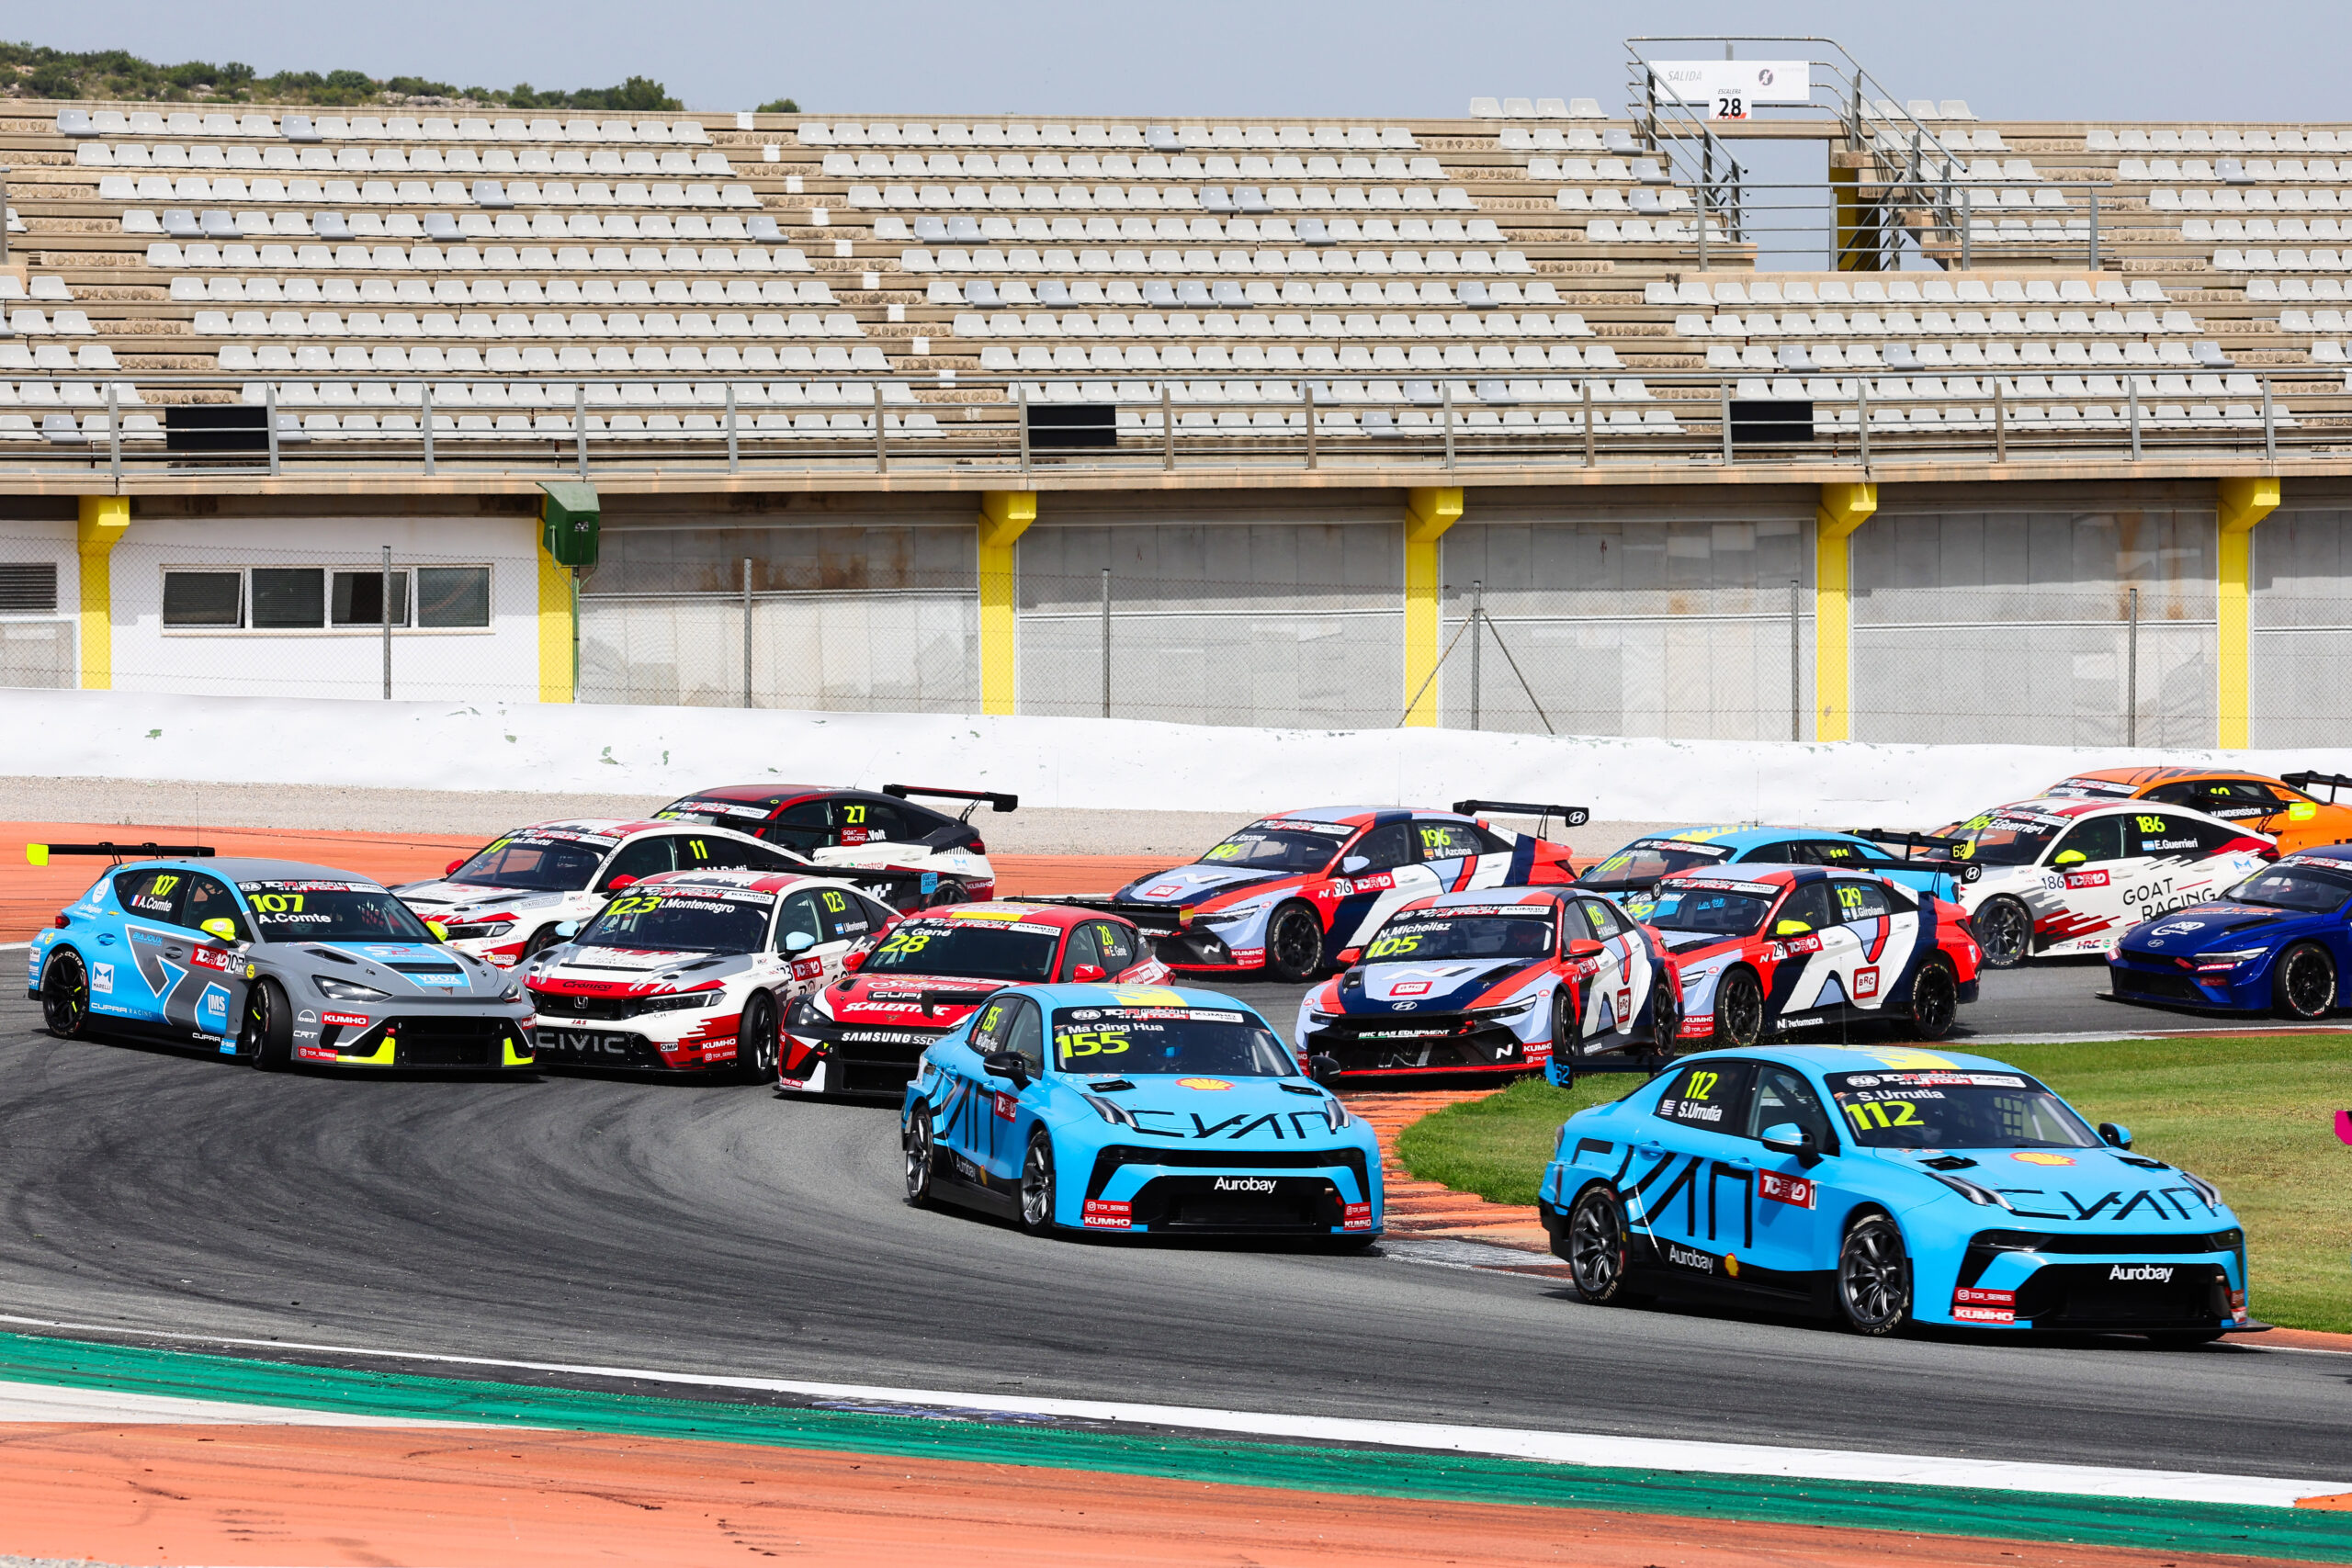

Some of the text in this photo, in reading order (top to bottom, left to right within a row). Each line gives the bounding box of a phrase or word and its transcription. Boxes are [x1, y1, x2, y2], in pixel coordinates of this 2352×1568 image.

[1668, 71, 1702, 82] SALIDA
[1719, 98, 1742, 117] 28
[843, 806, 865, 824] 27
[2136, 816, 2165, 833] 186
[1420, 829, 1452, 848] 196
[2154, 838, 2198, 850] E.Guerrieri
[482, 838, 514, 854] 11
[689, 840, 708, 860] 11
[1445, 847, 1472, 856] Azcona
[1952, 844, 1966, 858] 62
[855, 862, 884, 870] Castrol
[151, 874, 179, 896] 107
[967, 881, 993, 890] KUMHO
[1335, 881, 1352, 895] 96
[2041, 875, 2064, 890] 186
[730, 892, 771, 900] KUMHO
[1837, 886, 1862, 907] 129
[2122, 877, 2173, 906] GOAT
[139, 897, 173, 912] A.Comte
[248, 894, 304, 913] 107
[605, 897, 662, 917] 123
[658, 897, 736, 914] I.Montenegro
[822, 891, 846, 913] 123
[2142, 887, 2216, 921] RACING
[259, 913, 332, 924] A.Comte
[1587, 905, 1605, 926] 105
[911, 928, 952, 937] Gené
[1096, 925, 1114, 945] 28
[1377, 921, 1453, 940] N.Michelisz
[878, 935, 931, 953] 28
[1365, 935, 1424, 959] 105
[2076, 940, 2101, 950] HRC
[1231, 949, 1263, 957] KUMHO
[416, 974, 459, 983] VBOX
[1859, 976, 1873, 987] BRC
[93, 983, 111, 991] MARELLI
[562, 981, 614, 992] Crónica
[91, 1002, 153, 1018] CUPRA RACING
[208, 994, 225, 1012] IMS
[1619, 998, 1629, 1010] BRC
[323, 1014, 367, 1025] KUMHO
[981, 1006, 1003, 1032] 155
[1788, 1017, 1824, 1028] Performance
[293, 1030, 318, 1039] CRT
[1068, 1022, 1165, 1034] Ma Qing Hua
[192, 1032, 220, 1043] CUPRA
[537, 1032, 626, 1055] CIVIC
[702, 1038, 736, 1050] KUMHO
[841, 1032, 935, 1046] SAMSUNG SSD
[661, 1043, 678, 1052] OMP
[1056, 1032, 1130, 1058] 155
[1523, 1043, 1552, 1053] KUMHO
[308, 1050, 336, 1058] TCR_SERIES
[1555, 1064, 1570, 1084] 62
[1685, 1071, 1718, 1100] 112
[1857, 1089, 1945, 1101] S.Urrutia
[1678, 1101, 1723, 1122] S.Urrutia
[1845, 1100, 1925, 1131] 112
[1215, 1177, 1276, 1193] Aurobay
[1097, 1203, 1129, 1213] TCR_SERIES
[1084, 1216, 1131, 1227] KUMHO
[1345, 1217, 1372, 1228] KUMHO
[1669, 1244, 1713, 1274] Aurobay
[2109, 1264, 2174, 1282] Aurobay
[1971, 1292, 2012, 1302] TCR_SERIES
[1955, 1309, 2014, 1321] KUMHO
